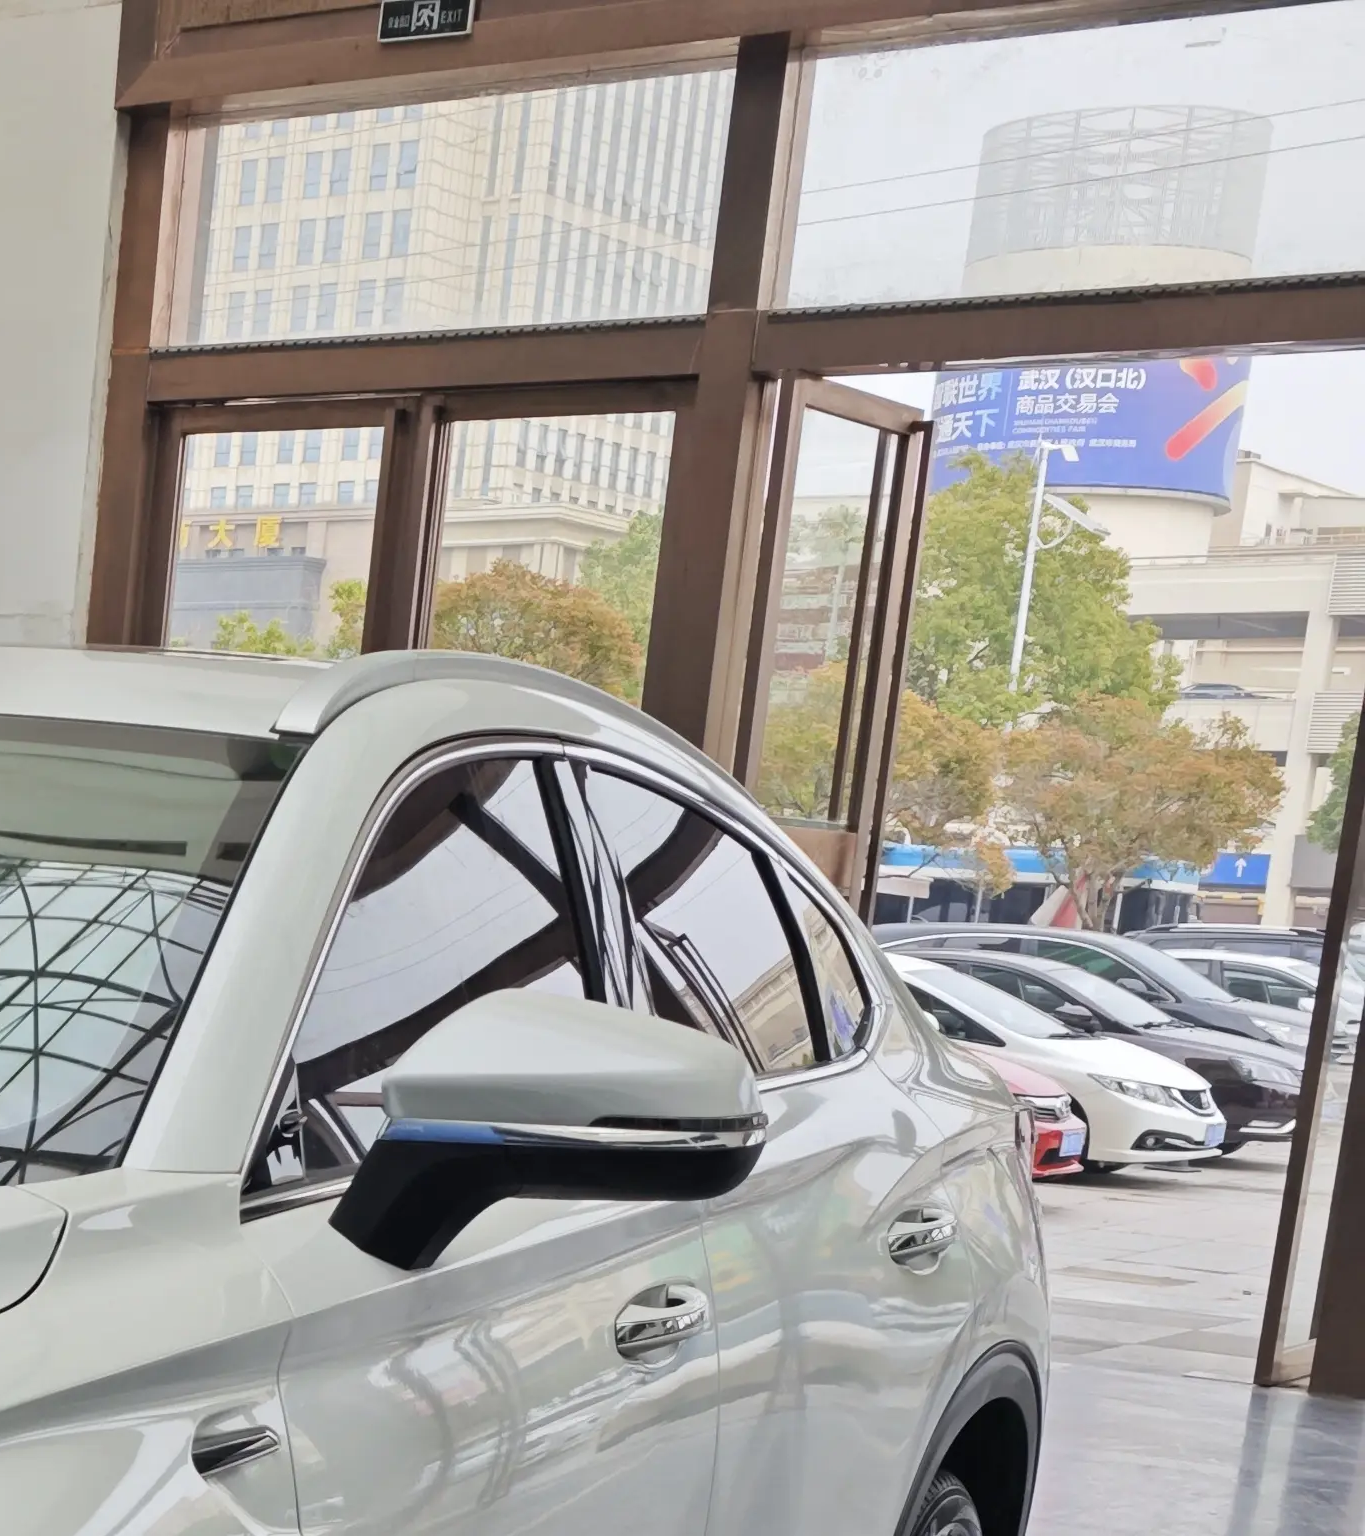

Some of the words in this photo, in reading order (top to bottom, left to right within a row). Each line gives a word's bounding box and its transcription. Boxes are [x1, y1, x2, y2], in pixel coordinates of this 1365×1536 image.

[440, 9, 463, 24] EXIT
[1015, 392, 1120, 415] 商品交易会
